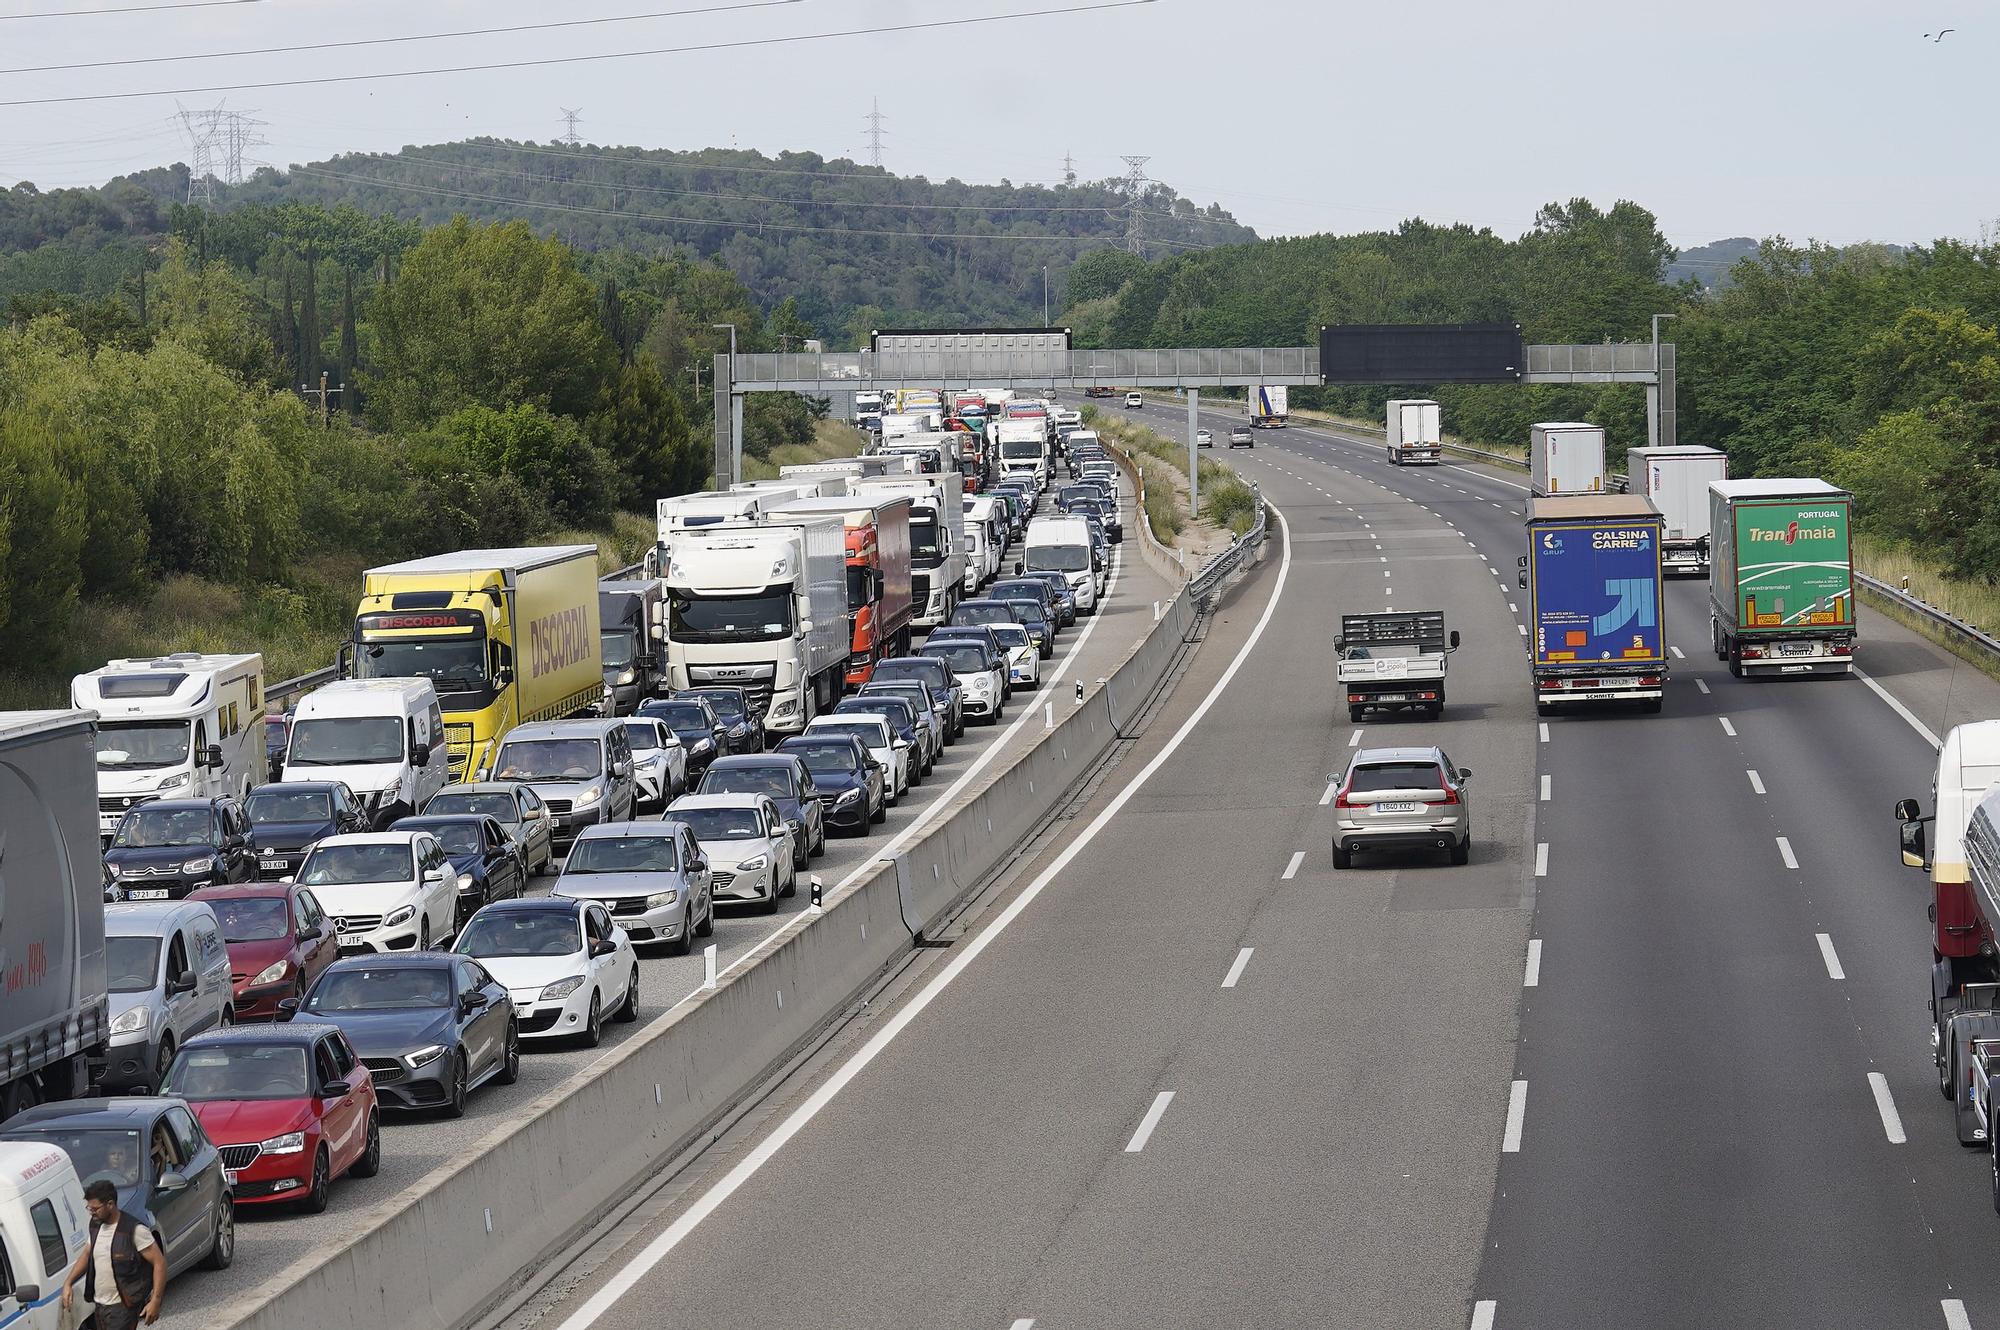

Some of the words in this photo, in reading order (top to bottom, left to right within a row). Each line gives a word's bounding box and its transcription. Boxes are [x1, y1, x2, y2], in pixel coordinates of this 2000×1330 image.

[1798, 511, 1840, 519] PORTUGAL
[1593, 530, 1649, 540] CALSINA
[379, 616, 457, 629] DISCORDIA
[530, 604, 590, 678] DISCORDIA
[347, 936, 360, 944] JTF
[28, 935, 48, 987] 1996
